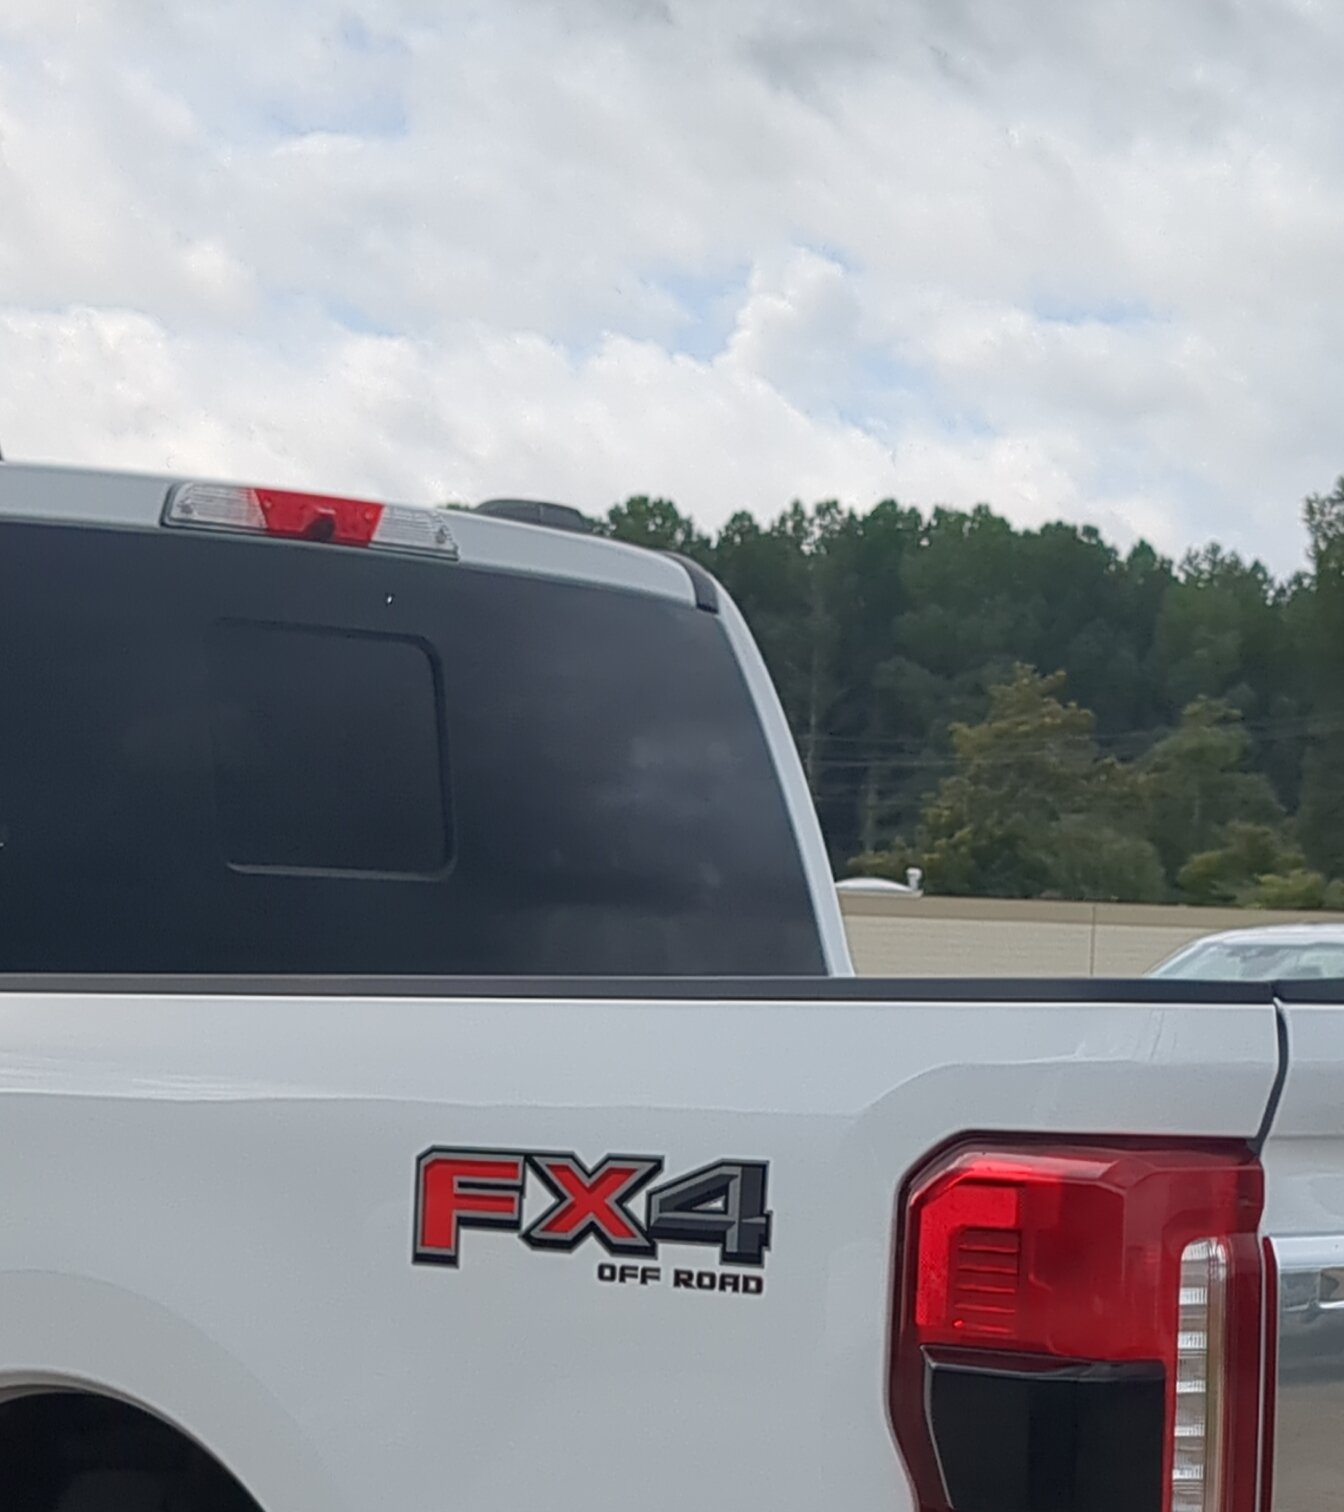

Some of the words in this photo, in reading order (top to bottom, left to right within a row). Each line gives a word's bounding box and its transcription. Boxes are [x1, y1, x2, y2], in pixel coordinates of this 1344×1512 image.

[412, 1145, 773, 1269] FX4
[597, 1262, 661, 1286] OFF
[672, 1268, 765, 1296] ROAD
